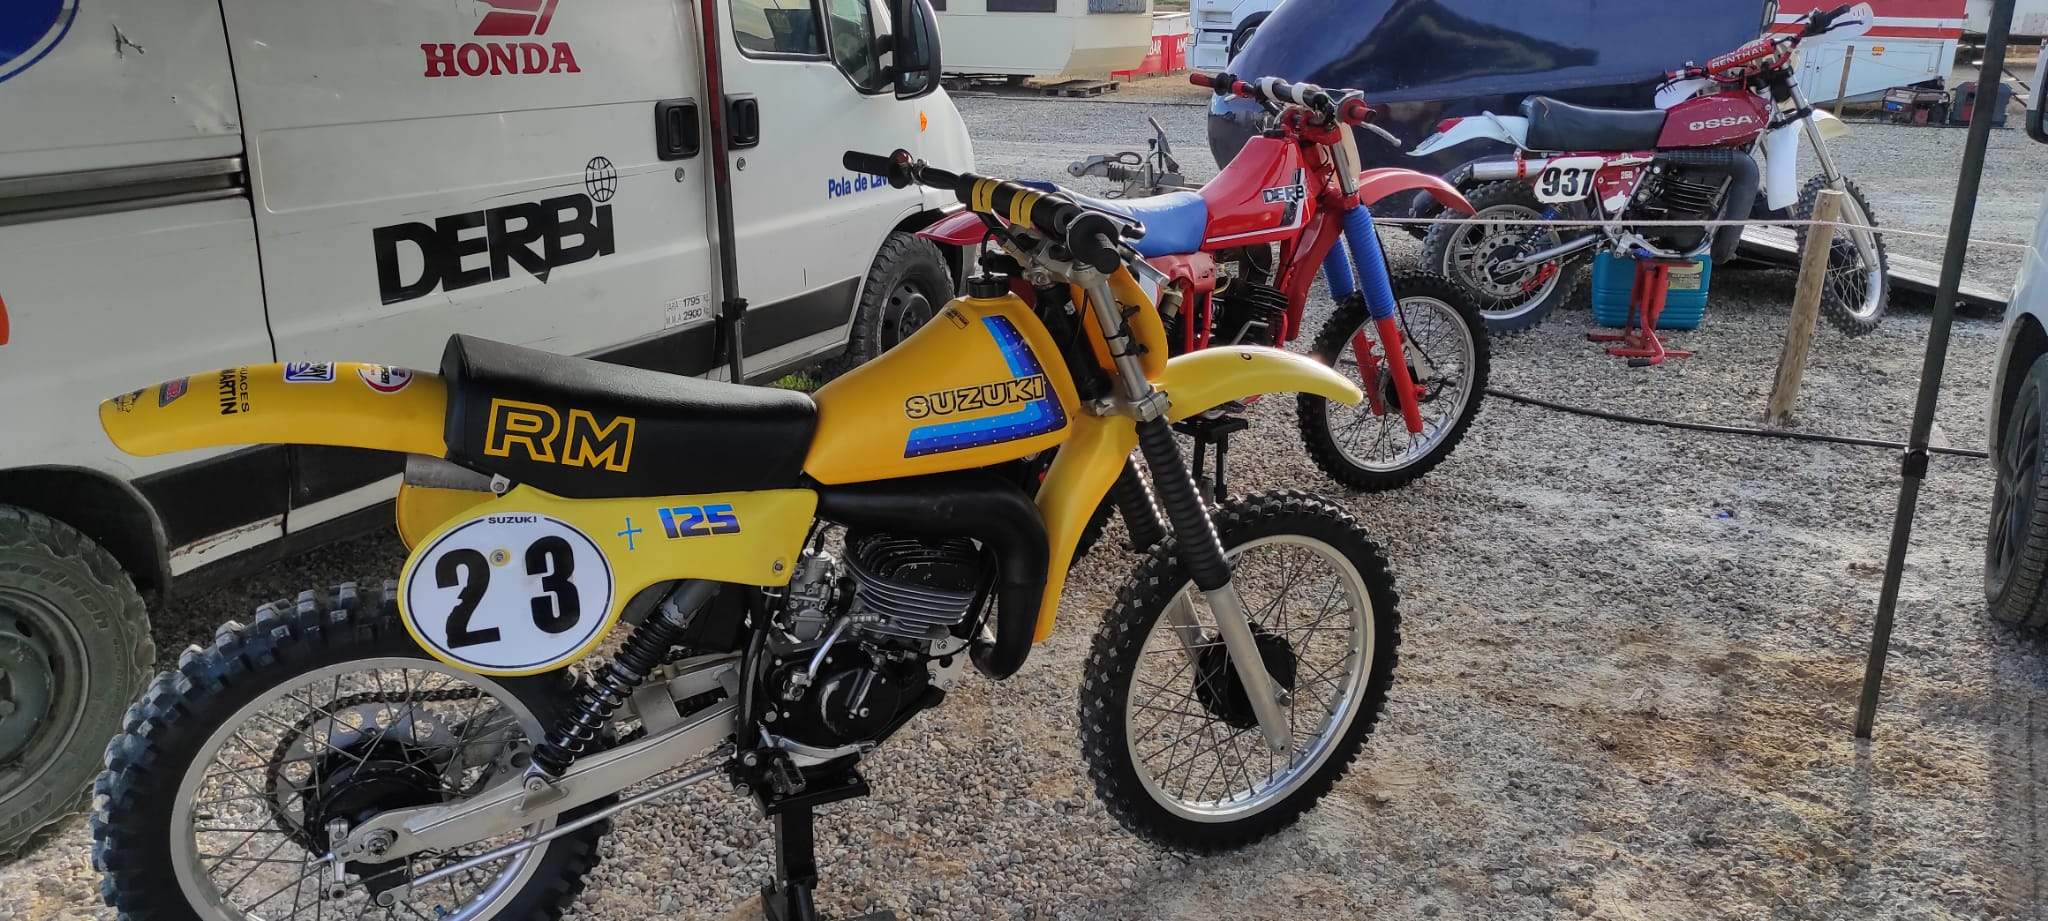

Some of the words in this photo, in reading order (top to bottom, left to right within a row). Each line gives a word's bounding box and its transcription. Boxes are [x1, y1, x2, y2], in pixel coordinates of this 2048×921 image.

[420, 42, 581, 78] HONDA
[1689, 115, 1752, 131] OSSA
[828, 176, 851, 199] Pola
[854, 173, 868, 192] de
[1541, 166, 1596, 197] 937
[683, 295, 701, 308] 1795
[683, 308, 702, 321] 2900
[905, 375, 1045, 419] SUZUKI
[484, 398, 636, 472] RM
[488, 516, 537, 525] SUZUKI
[657, 503, 742, 540] 125
